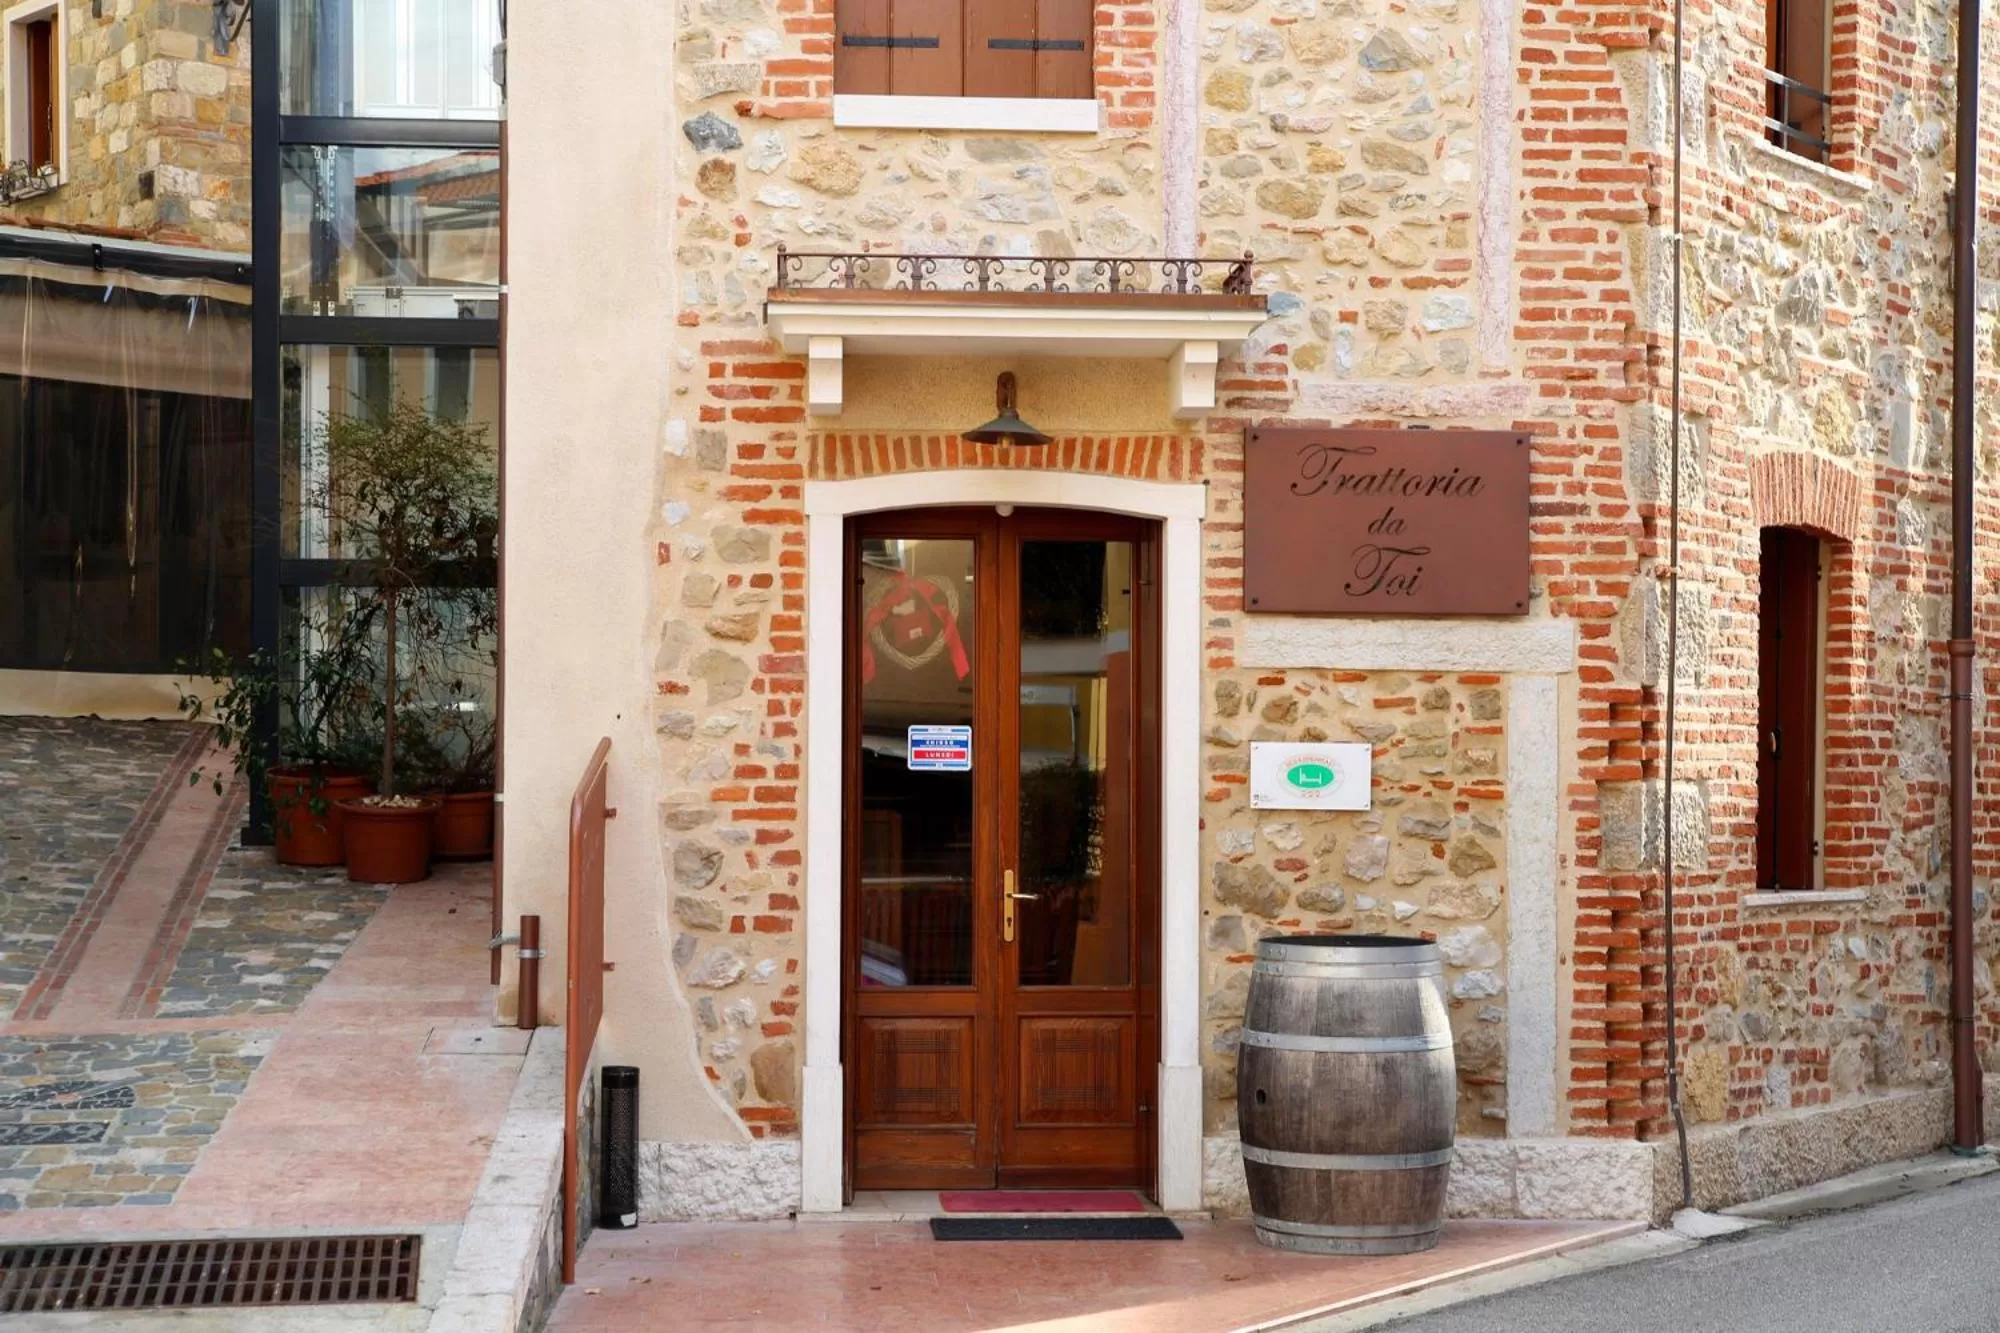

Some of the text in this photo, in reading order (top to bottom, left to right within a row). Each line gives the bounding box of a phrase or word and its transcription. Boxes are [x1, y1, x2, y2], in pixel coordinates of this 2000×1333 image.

[1290, 443, 1484, 497] Trattoria
[1367, 505, 1406, 536] da
[1344, 543, 1432, 597] Toi
